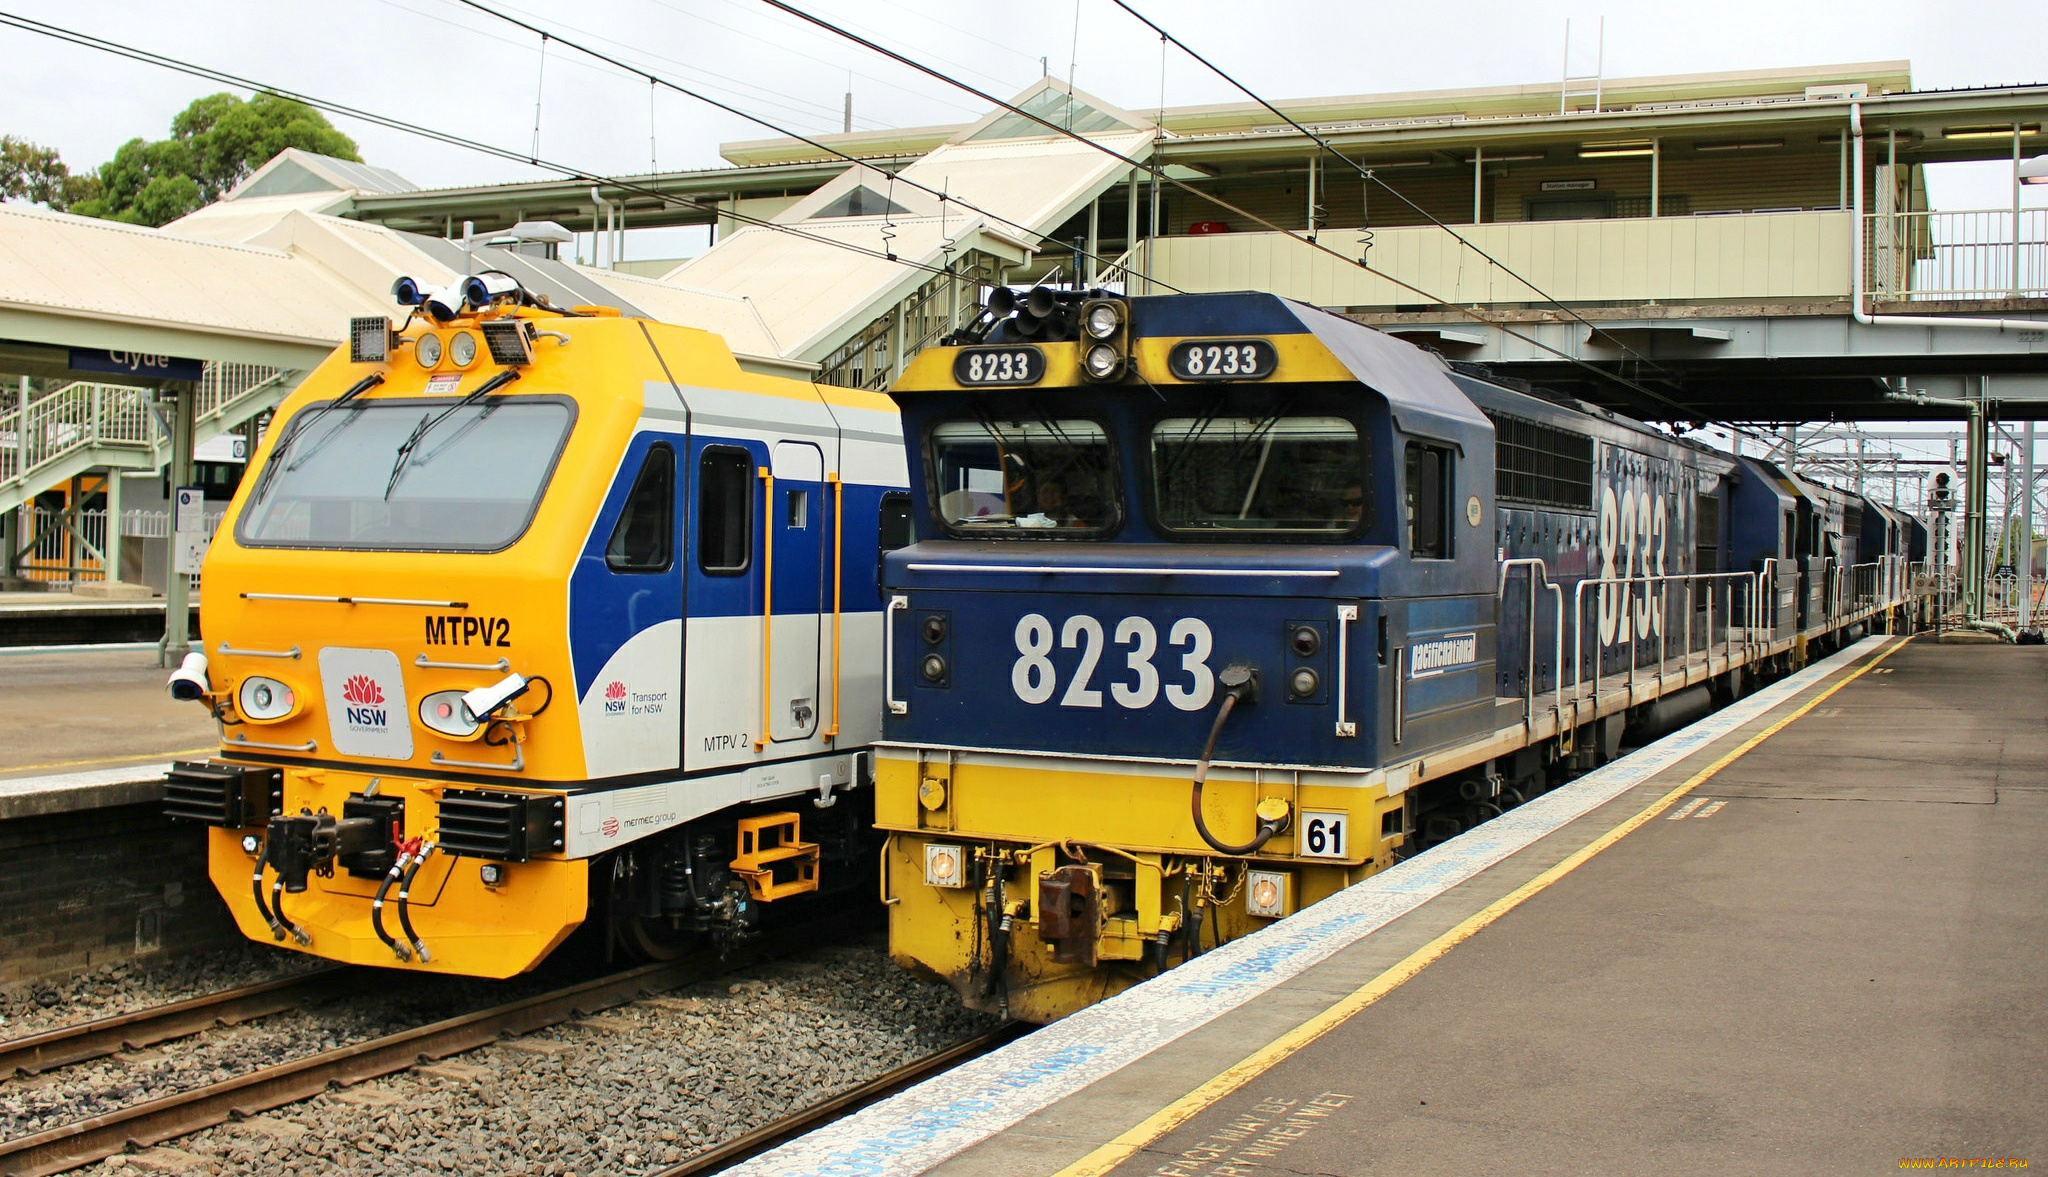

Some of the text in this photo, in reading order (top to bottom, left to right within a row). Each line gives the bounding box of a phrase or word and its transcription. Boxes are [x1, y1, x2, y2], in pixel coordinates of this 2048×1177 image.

[969, 353, 1028, 381] 8233
[1187, 346, 1257, 375] 8233
[233, 440, 245, 457] 6
[1600, 486, 1666, 647] 8233
[425, 615, 511, 647] MTPV2
[1011, 613, 1215, 711] 8233
[605, 701, 626, 712] NSW
[632, 692, 667, 703] Transport
[347, 707, 386, 726] NSW
[631, 704, 663, 715] for NSW
[349, 725, 388, 734] GOVERNMENT
[704, 733, 748, 752] MTPV 2
[655, 812, 677, 825] group
[1307, 818, 1341, 854] 61
[1238, 1118, 1319, 1157] WHEN
[1294, 1091, 1354, 1117] WET
[1148, 1096, 1300, 1177] FACE MAY BE
